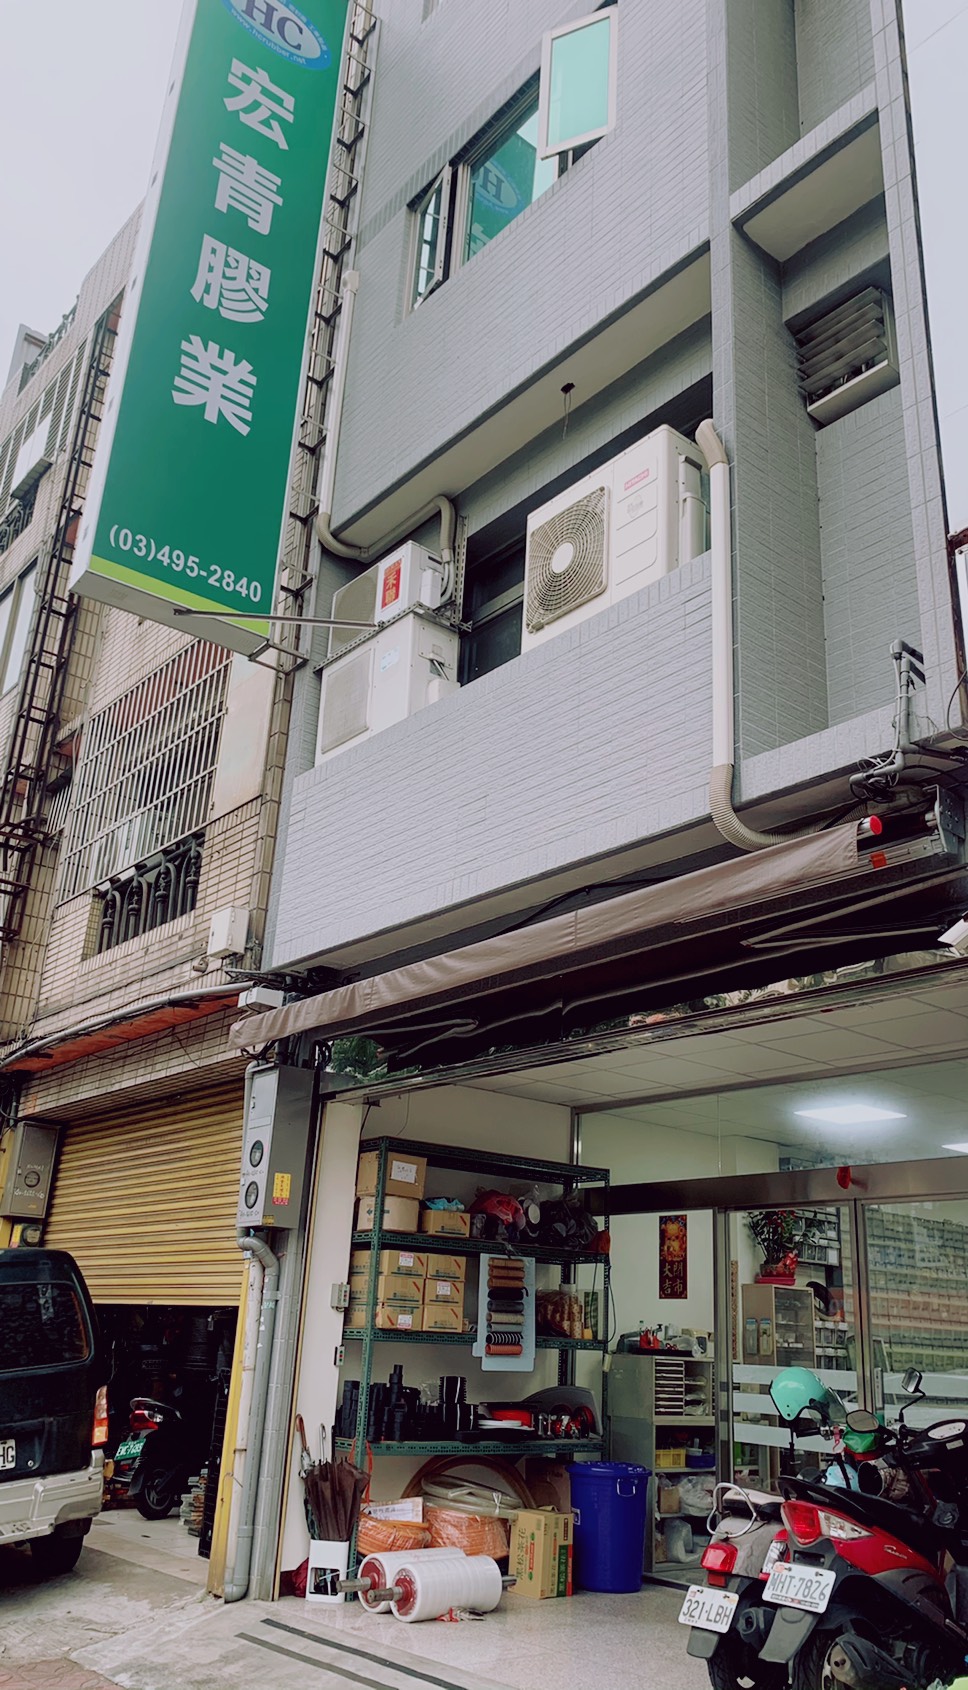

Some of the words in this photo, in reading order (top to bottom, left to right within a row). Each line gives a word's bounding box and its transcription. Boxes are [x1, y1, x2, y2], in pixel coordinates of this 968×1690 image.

[230, 8, 307, 65] www.hcrubber.net
[241, 0, 304, 51] HC
[171, 57, 295, 437] 宏青膠業
[109, 523, 263, 603] (03)495-2840
